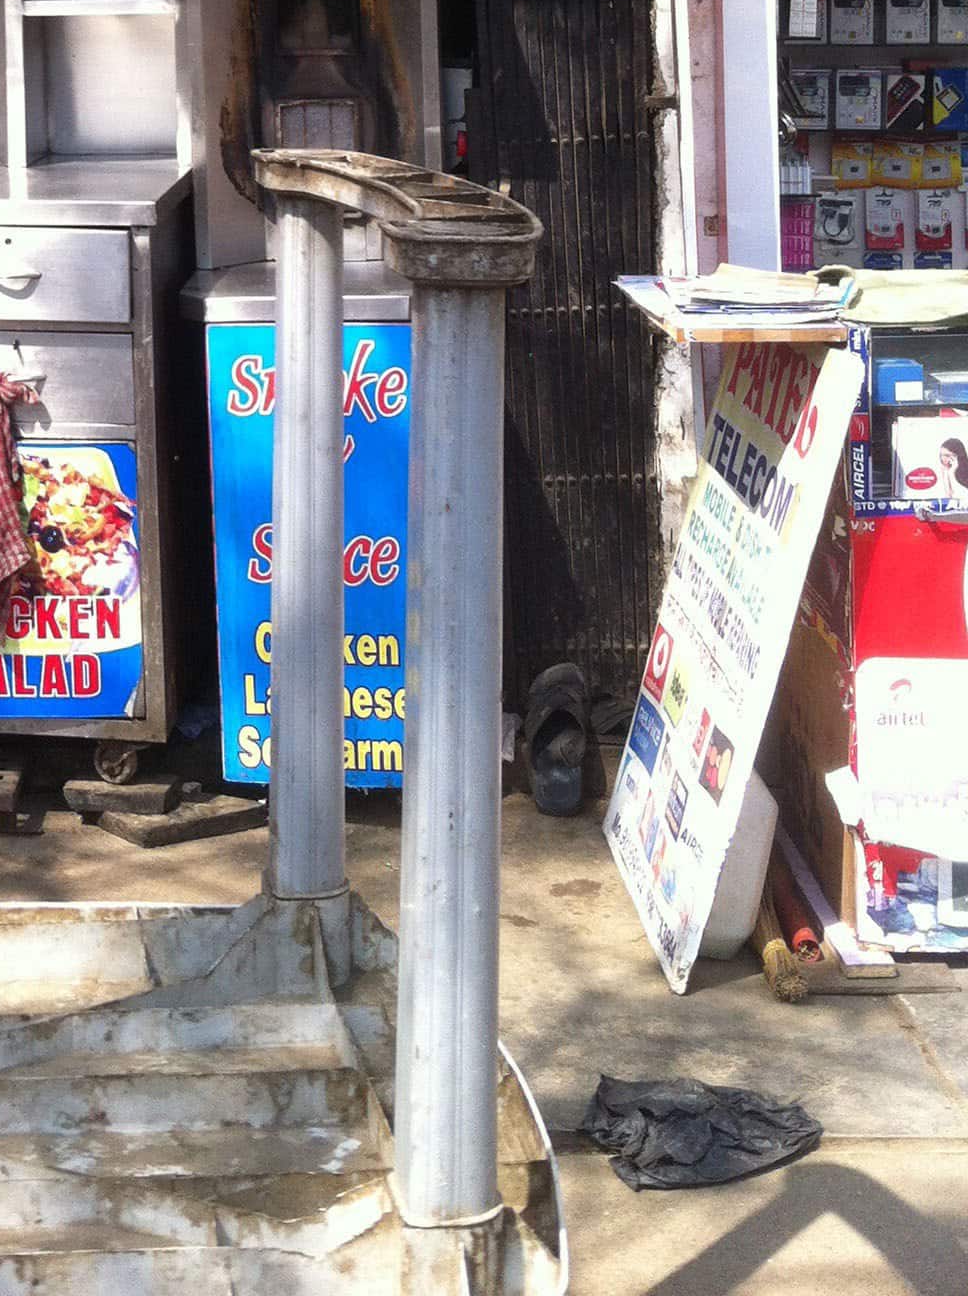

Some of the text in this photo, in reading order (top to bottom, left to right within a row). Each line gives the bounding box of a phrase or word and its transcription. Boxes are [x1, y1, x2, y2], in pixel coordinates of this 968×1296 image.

[708, 412, 794, 536] TELECOM
[853, 444, 865, 500] AIRCEL
[703, 480, 736, 533] MOBILE
[876, 711, 927, 726] airtel
